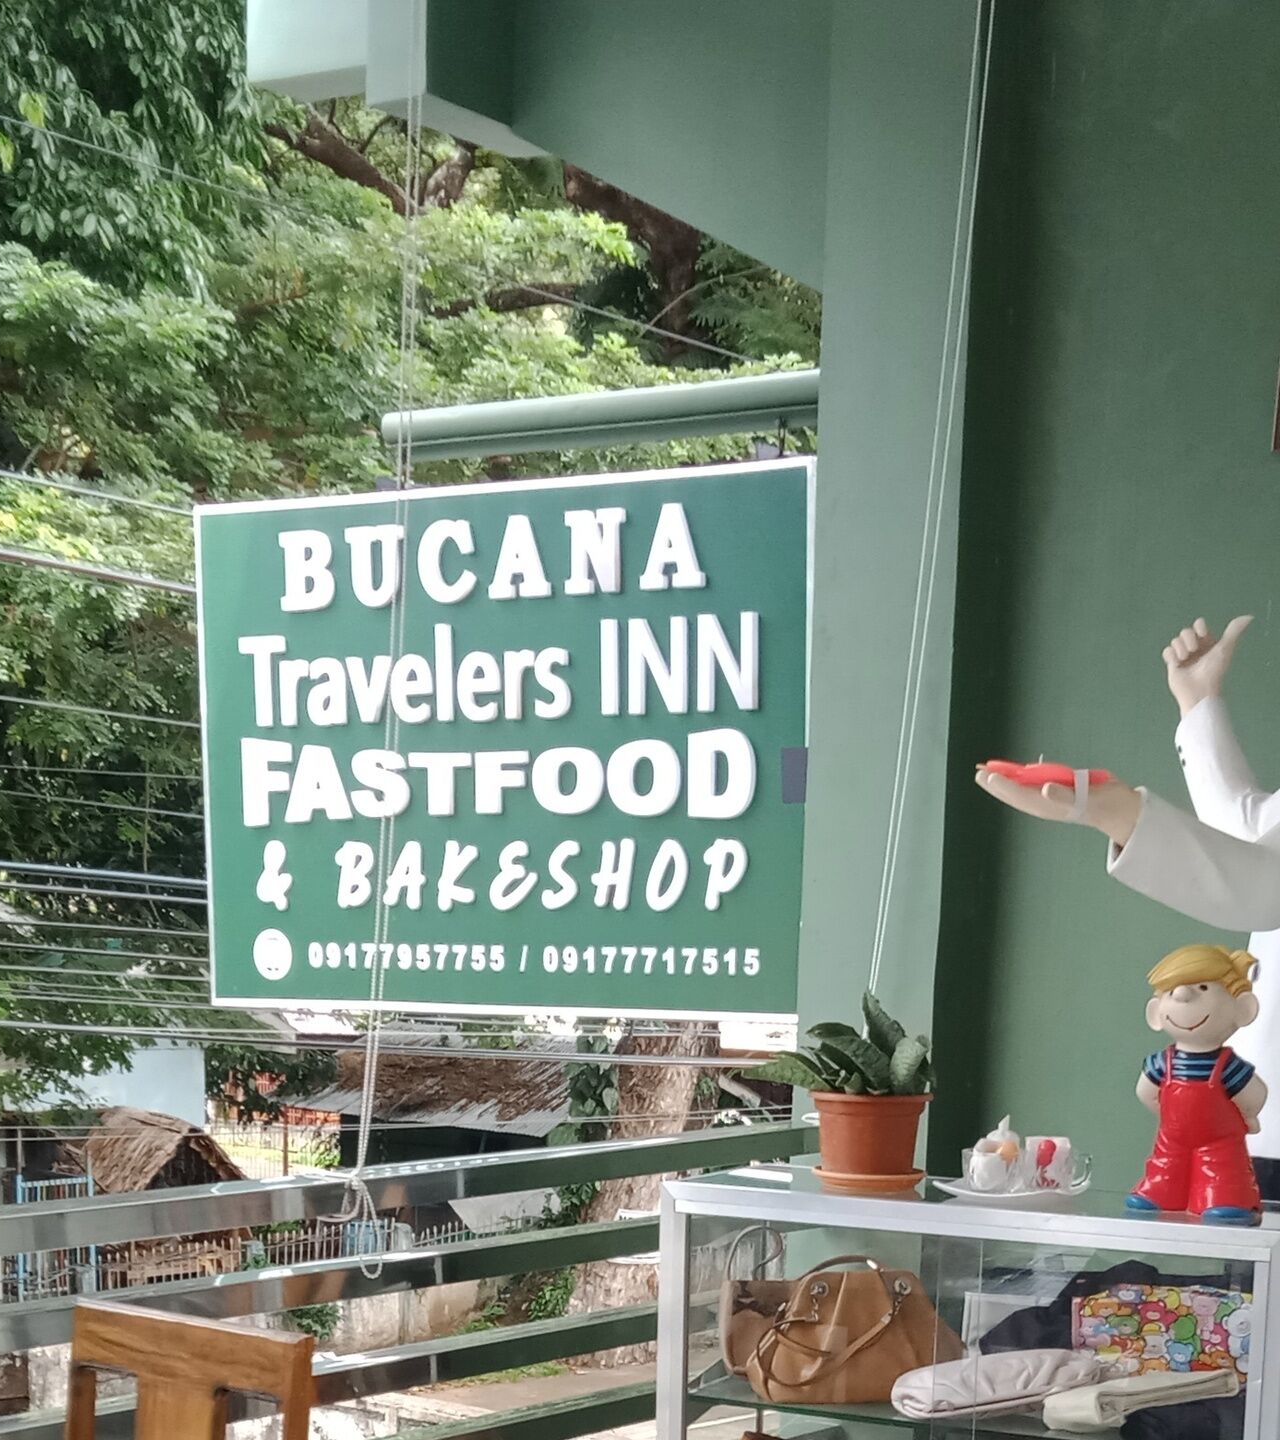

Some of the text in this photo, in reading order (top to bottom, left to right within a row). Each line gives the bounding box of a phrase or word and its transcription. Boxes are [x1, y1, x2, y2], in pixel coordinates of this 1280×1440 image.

[278, 502, 707, 612] BUCANA
[238, 611, 761, 728] Travelers INN
[240, 728, 756, 828] FASTFOOD
[256, 837, 748, 912] & BAKESHOP
[308, 941, 506, 973] 09177957755
[542, 945, 762, 977] 09177717515
